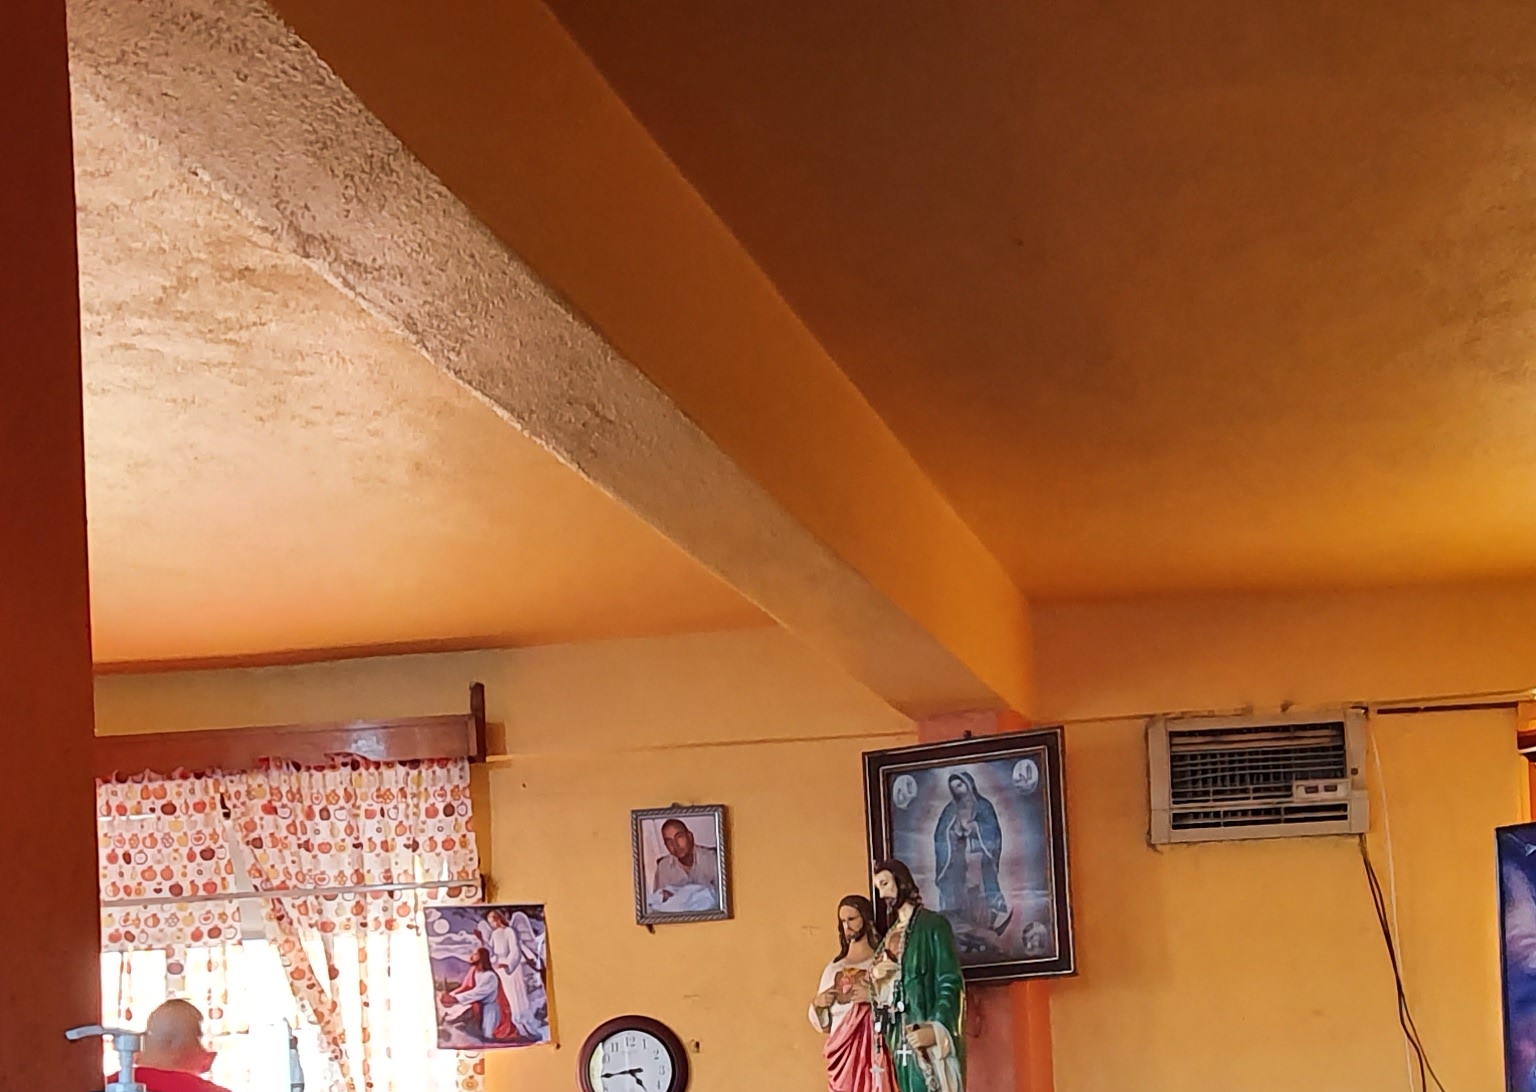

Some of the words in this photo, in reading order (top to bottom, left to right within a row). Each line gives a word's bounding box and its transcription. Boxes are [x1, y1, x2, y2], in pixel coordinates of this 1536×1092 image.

[610, 1041, 619, 1053] 11
[625, 1036, 636, 1048] 12
[653, 1049, 660, 1061] 2
[659, 1065, 666, 1076] 3
